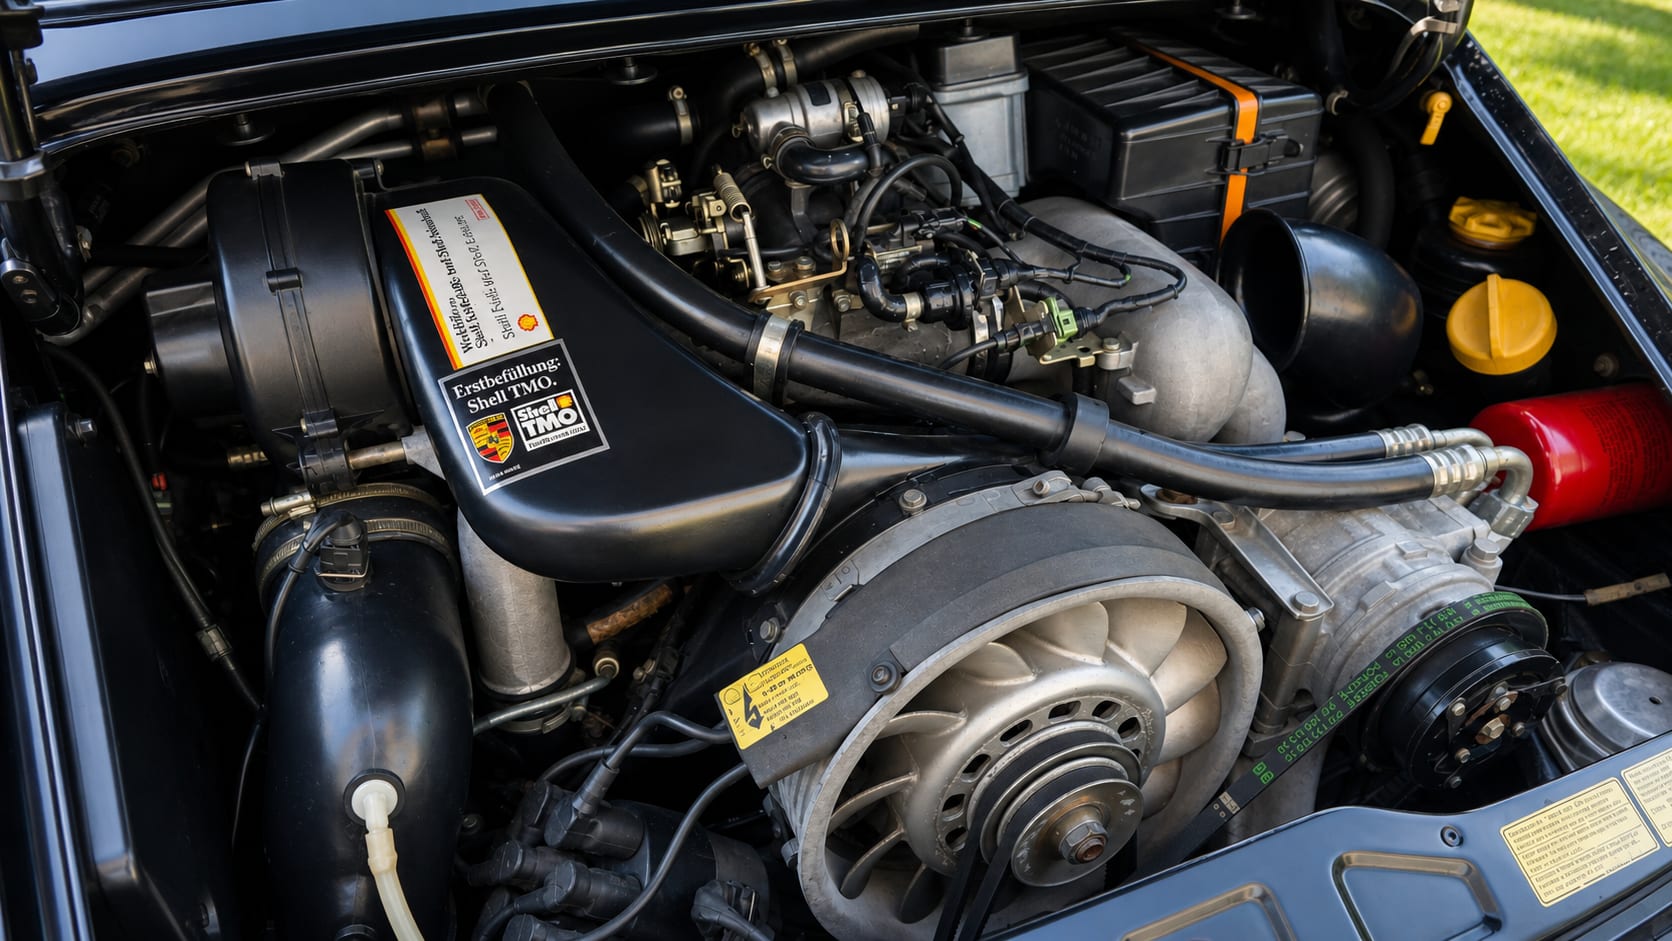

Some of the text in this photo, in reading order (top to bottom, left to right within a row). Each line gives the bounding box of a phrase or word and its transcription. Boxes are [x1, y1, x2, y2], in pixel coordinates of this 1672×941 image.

[453, 357, 561, 399] Erstbefüllung:
[467, 375, 557, 414] Shell TMO.
[521, 408, 578, 437] TMO
